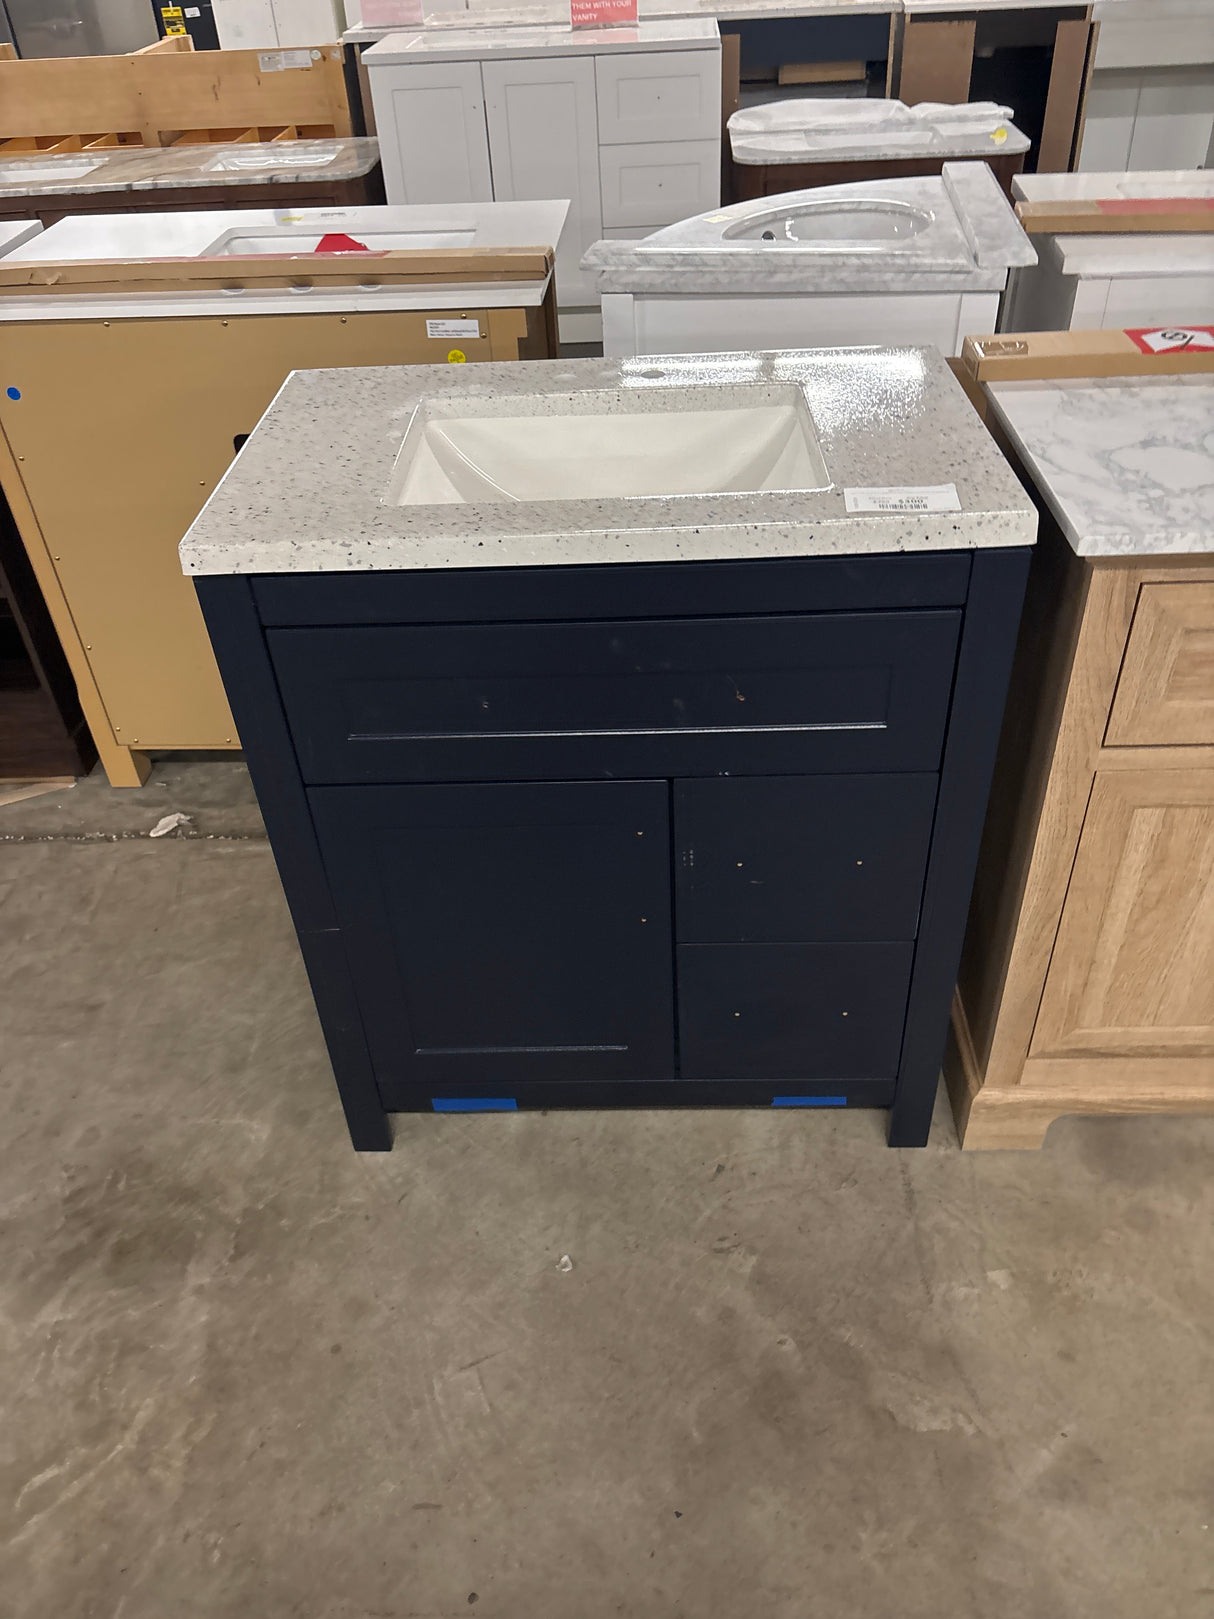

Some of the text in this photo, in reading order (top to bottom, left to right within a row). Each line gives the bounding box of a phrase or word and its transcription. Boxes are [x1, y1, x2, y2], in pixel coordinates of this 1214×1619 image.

[572, 0, 632, 10] THEM WITH YOUR
[572, 13, 598, 21] VANITY
